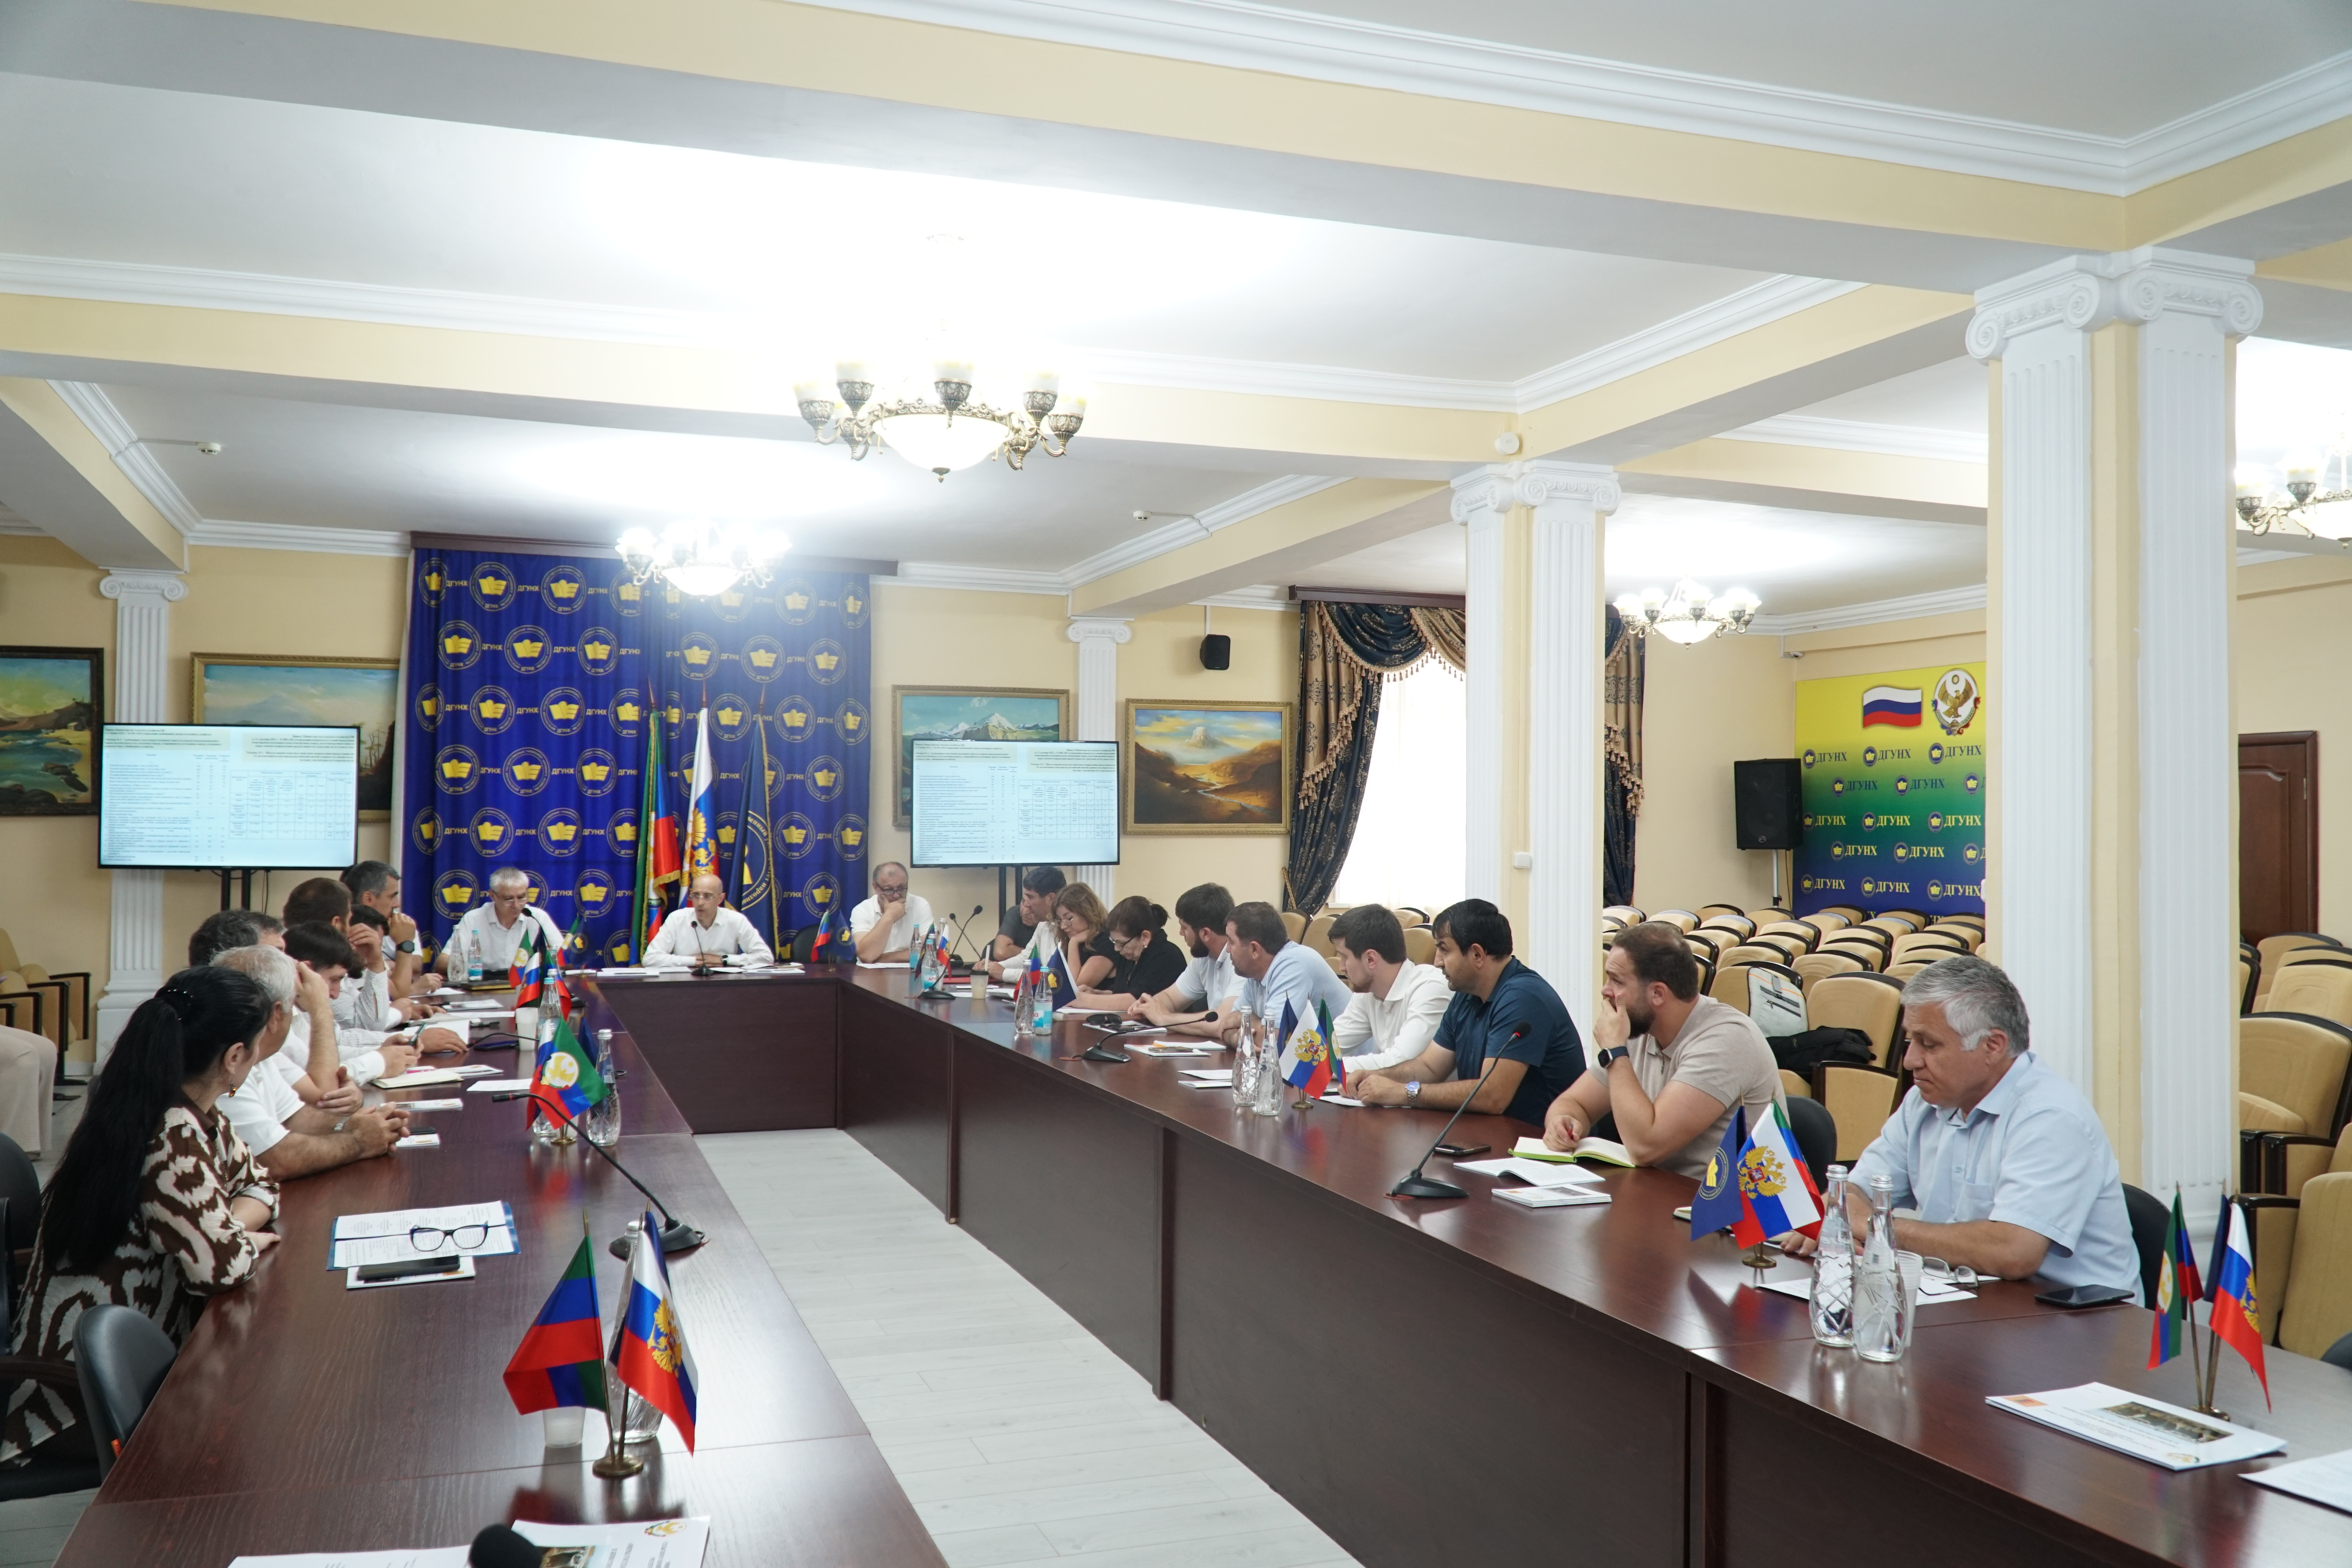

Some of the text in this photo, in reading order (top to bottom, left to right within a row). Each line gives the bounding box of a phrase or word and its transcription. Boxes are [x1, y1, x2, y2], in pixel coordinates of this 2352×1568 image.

[1878, 750, 1911, 761] ДГУНХ
[1945, 746, 1982, 758] ДГУНХ
[1817, 753, 1846, 763] ДГУНХ
[1846, 781, 1877, 791] ДГУНХ
[1910, 779, 1944, 790] ДГУНХ
[1815, 816, 1846, 826] ДГУНХ
[1877, 816, 1910, 826] ДГУНХ
[1944, 815, 1981, 827] ДГУНХ
[1845, 846, 1877, 856] ДГУНХ
[1909, 847, 1944, 857] ДГУНХ
[1815, 879, 1845, 889] ДГУНХ
[1876, 882, 1909, 893] ДГУНХ
[1944, 884, 1980, 897] ДГУНХ
